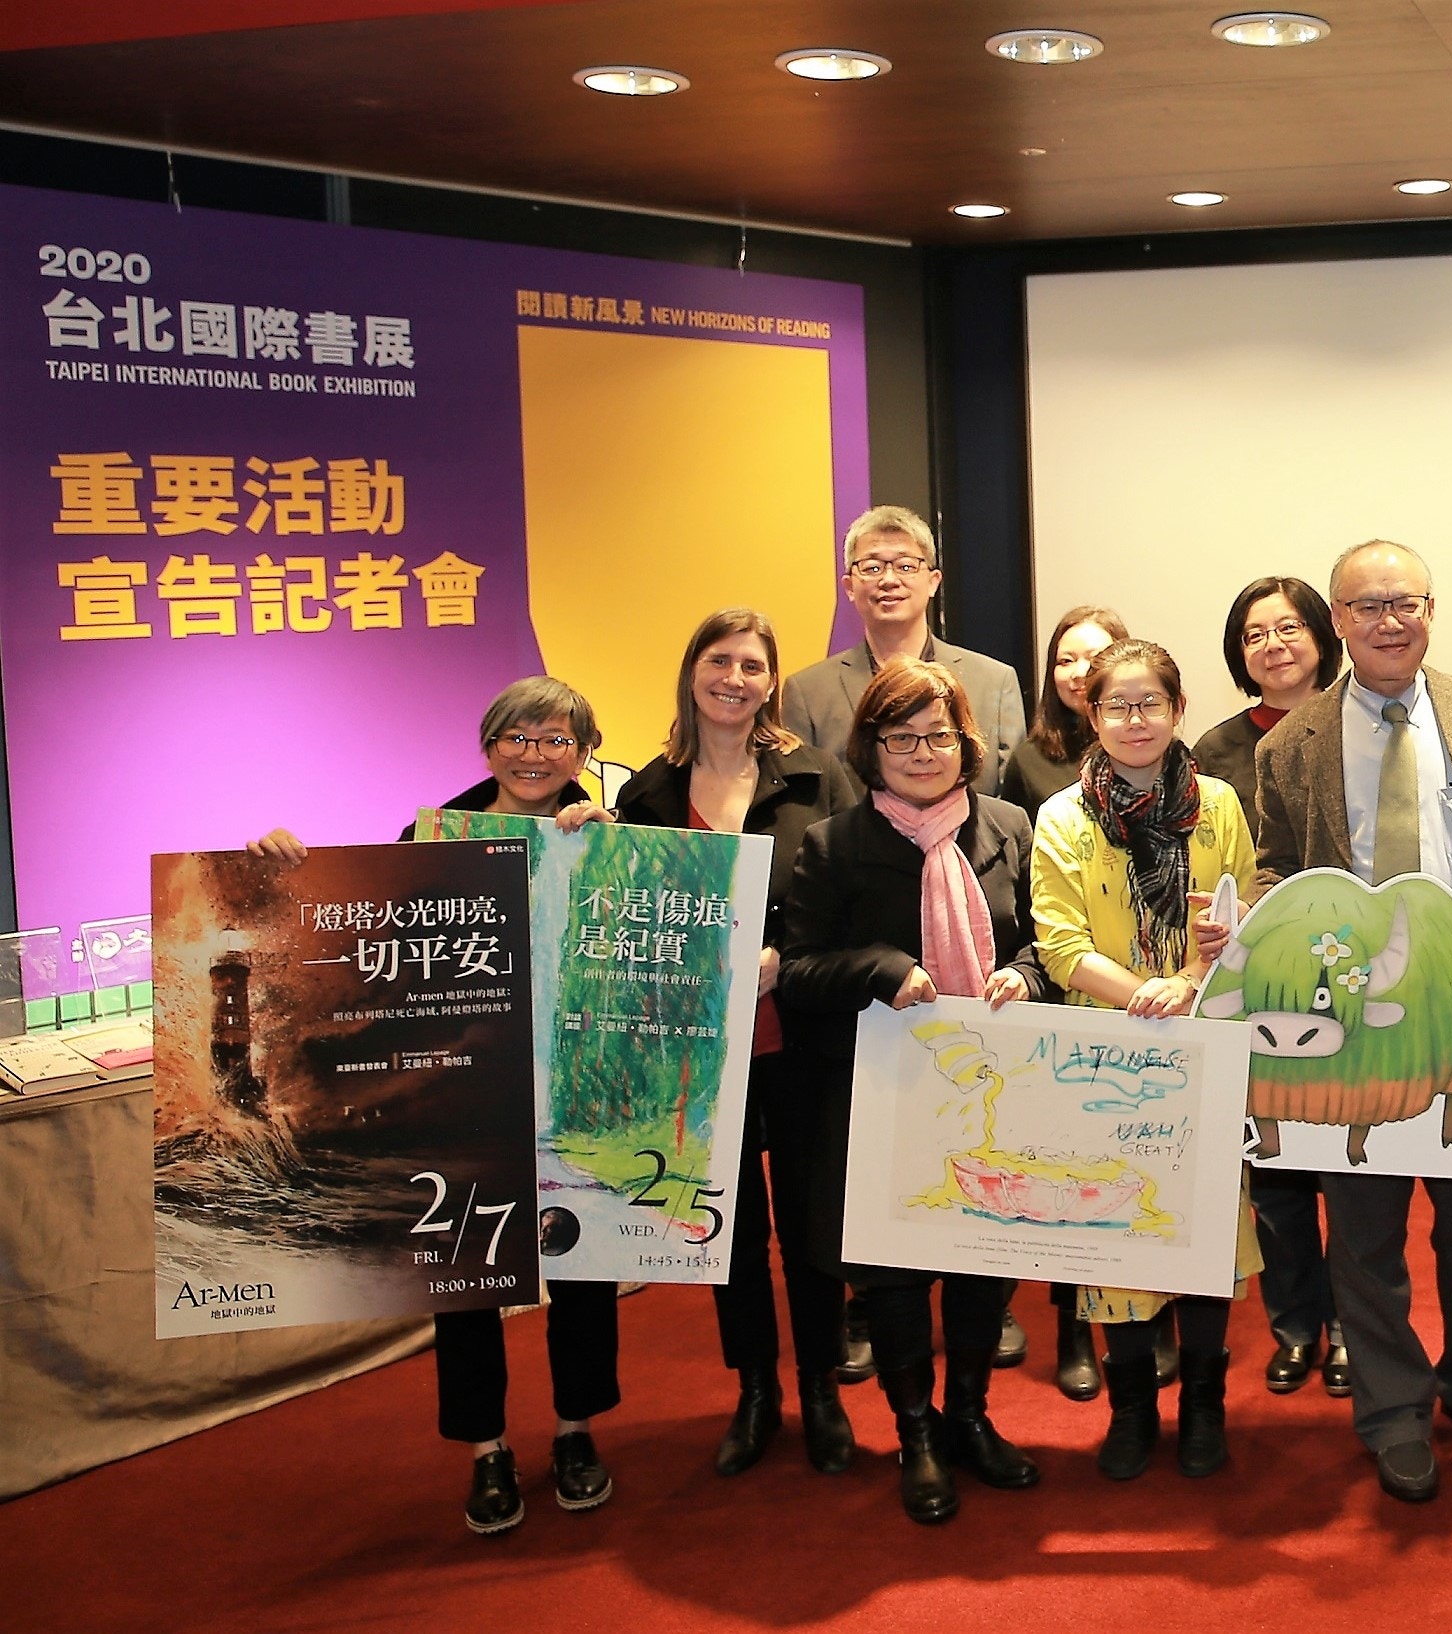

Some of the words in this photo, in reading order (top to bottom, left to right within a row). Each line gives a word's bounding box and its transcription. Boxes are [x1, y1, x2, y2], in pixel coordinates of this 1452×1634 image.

[39, 244, 151, 285] 2020
[517, 290, 645, 326] 閱讀新風景
[652, 307, 686, 325] NEW
[688, 311, 756, 332] HORIZONS
[758, 317, 776, 334] OF
[777, 319, 831, 339] READING
[42, 289, 415, 369] 台北國際書展
[45, 360, 109, 382] TAIPEI
[116, 364, 262, 390] INTERNATIONAL
[269, 373, 317, 393] BOOK
[324, 376, 416, 397] EXHIBITION
[50, 452, 405, 536] 重要活動
[57, 551, 486, 641] 宣告記者會
[573, 924, 688, 966] 是紀實
[406, 992, 443, 1002] Ar-men
[628, 1148, 725, 1245] 2/5
[410, 1171, 516, 1266] 2/7
[619, 1224, 657, 1238] WED.
[413, 1250, 443, 1265] FRI.
[638, 1254, 673, 1267] 14:45
[685, 1255, 720, 1268] 15:45
[428, 1278, 466, 1294] 18:00
[479, 1275, 516, 1290] 19:00
